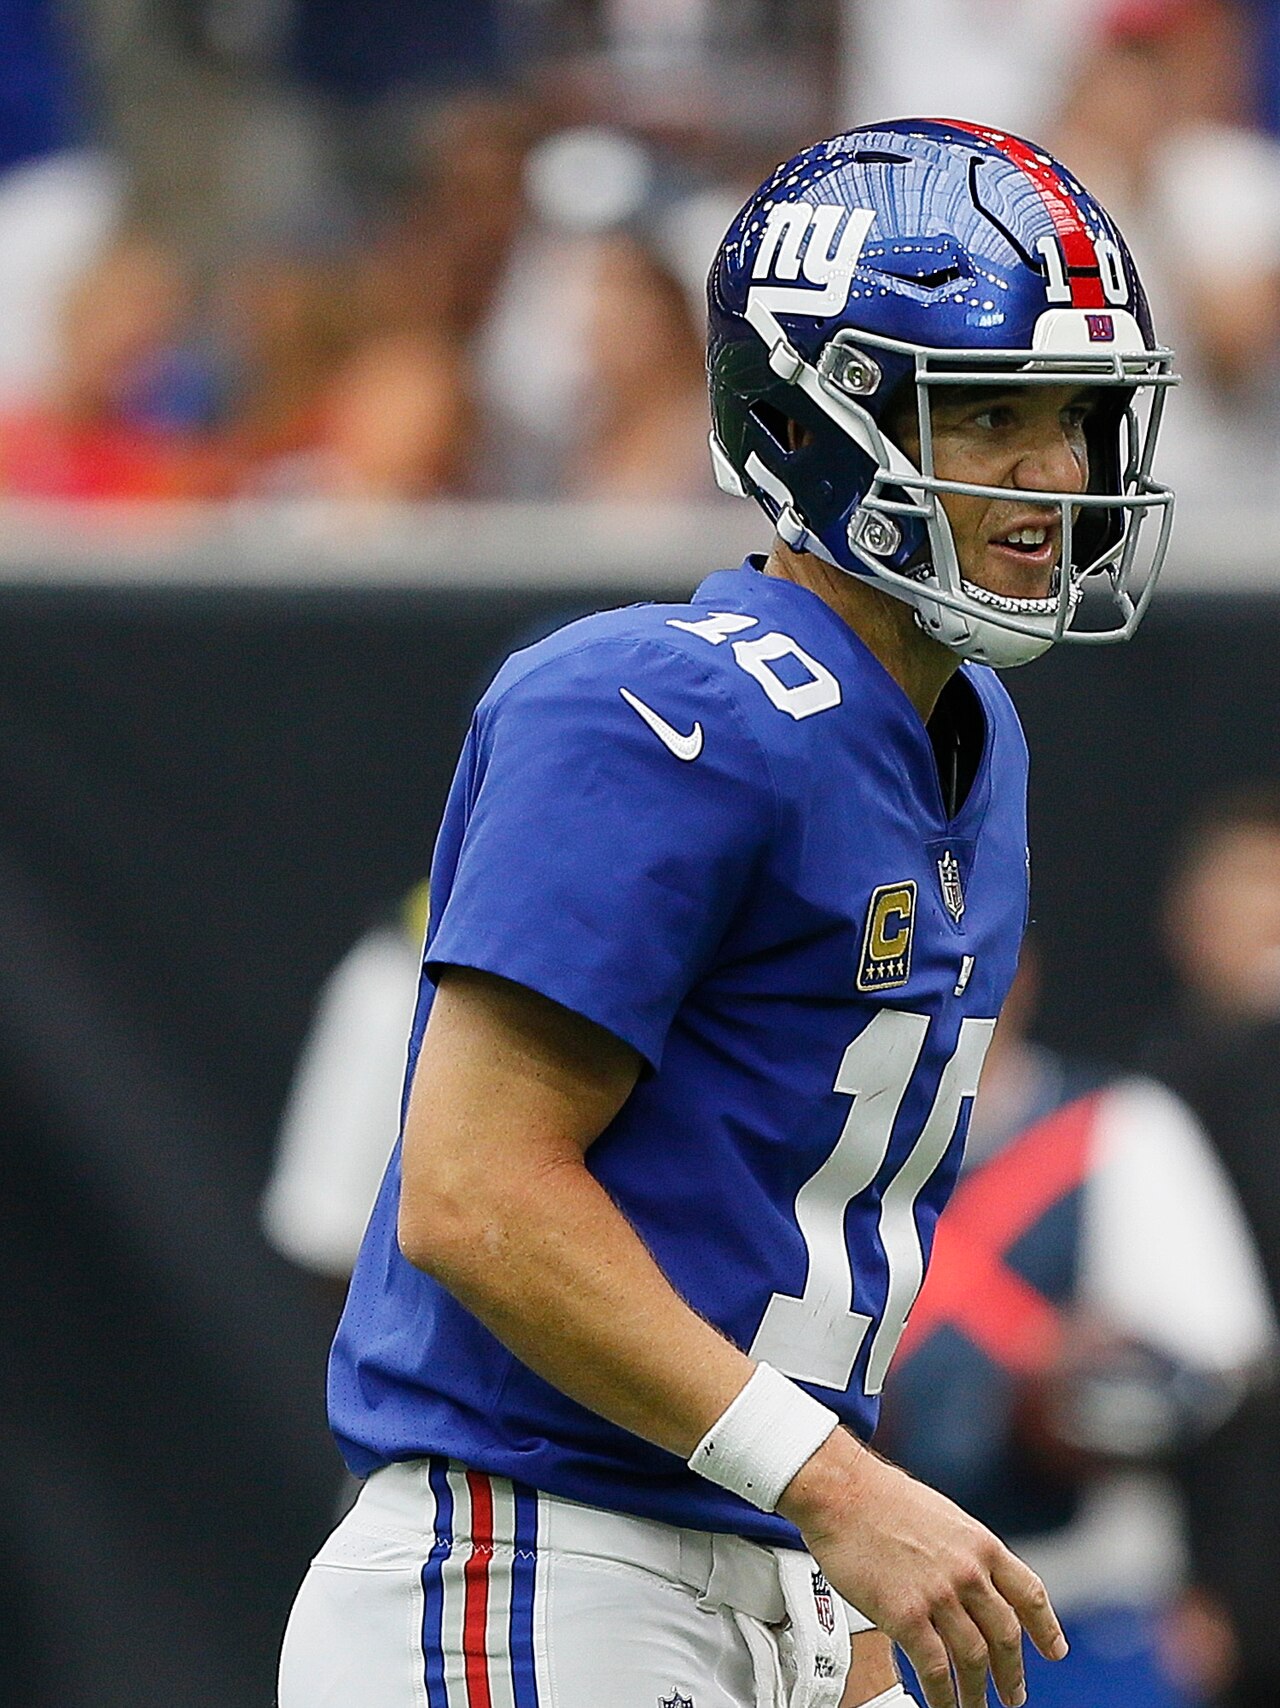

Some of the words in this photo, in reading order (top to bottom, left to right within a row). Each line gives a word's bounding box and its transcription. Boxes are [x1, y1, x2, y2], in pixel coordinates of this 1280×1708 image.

[744, 201, 876, 318] ny
[1036, 235, 1130, 306] 10
[666, 611, 843, 720] 10
[869, 890, 912, 960] C
